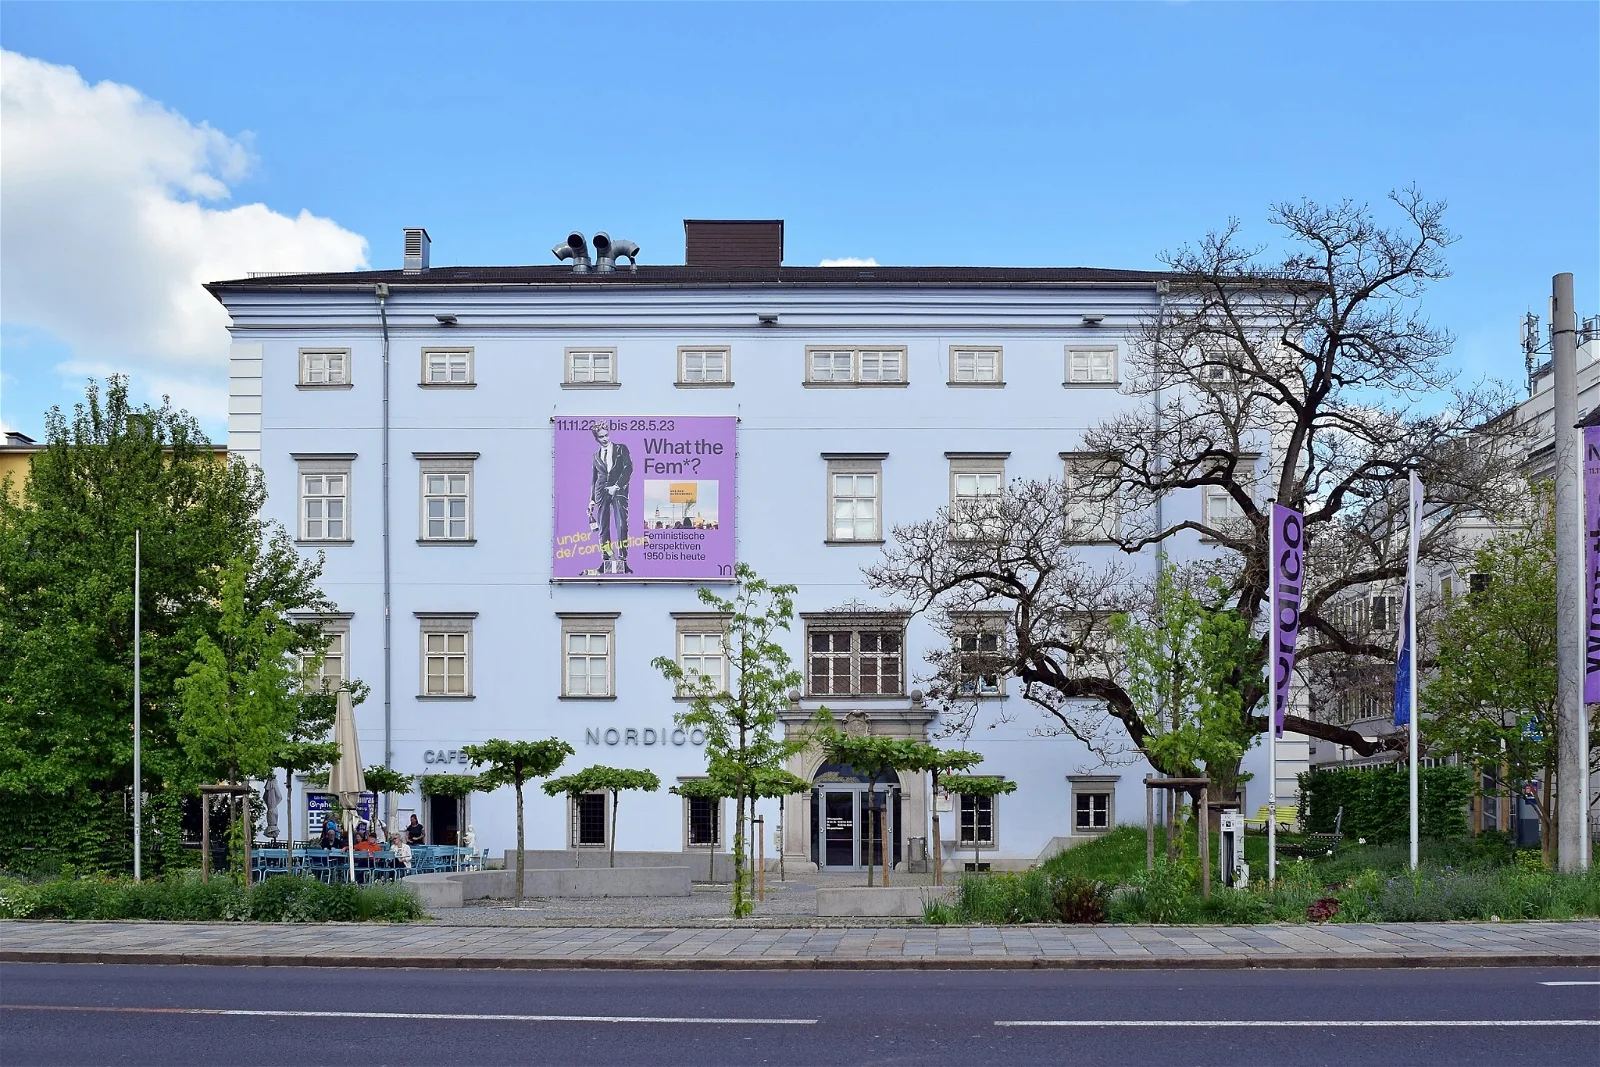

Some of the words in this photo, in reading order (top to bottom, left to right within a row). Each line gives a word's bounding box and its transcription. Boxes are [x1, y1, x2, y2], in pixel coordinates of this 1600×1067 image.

[557, 419, 597, 431] 11.11.22
[609, 419, 628, 431] bis
[630, 419, 675, 432] 28.5.23
[643, 438, 692, 455] What
[694, 438, 724, 455] the
[556, 531, 592, 546] under
[643, 530, 705, 541] Feministische
[643, 541, 701, 552] Perspektiven
[643, 551, 664, 561] 1950
[665, 551, 679, 561] bis
[680, 551, 706, 561] heute
[585, 726, 706, 746] NORDICO
[423, 749, 468, 764] CAFE
